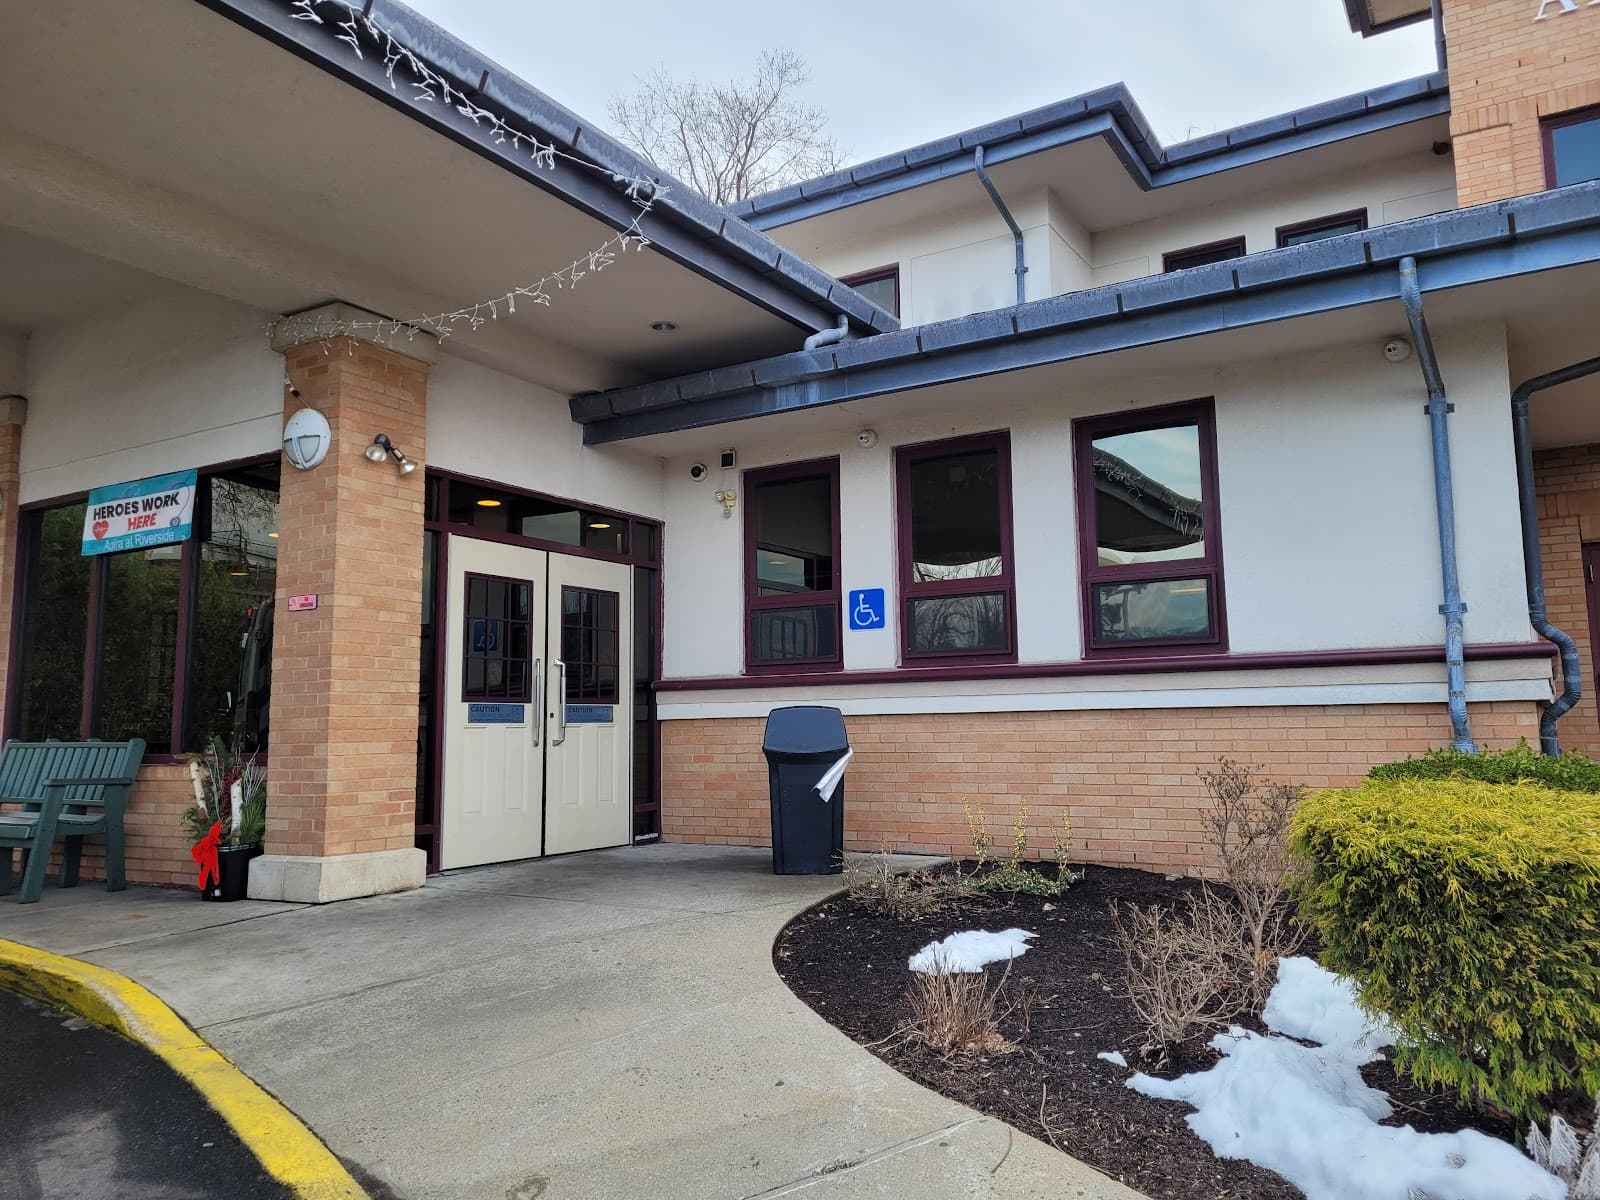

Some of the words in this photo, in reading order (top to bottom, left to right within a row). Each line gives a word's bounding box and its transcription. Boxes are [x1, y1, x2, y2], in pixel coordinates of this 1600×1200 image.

[93, 502, 139, 520] HEROES
[142, 492, 179, 511] WORK
[127, 513, 157, 531] HERE
[125, 537, 133, 548] at
[135, 531, 175, 546] Riverside
[470, 705, 500, 713] CAUTION
